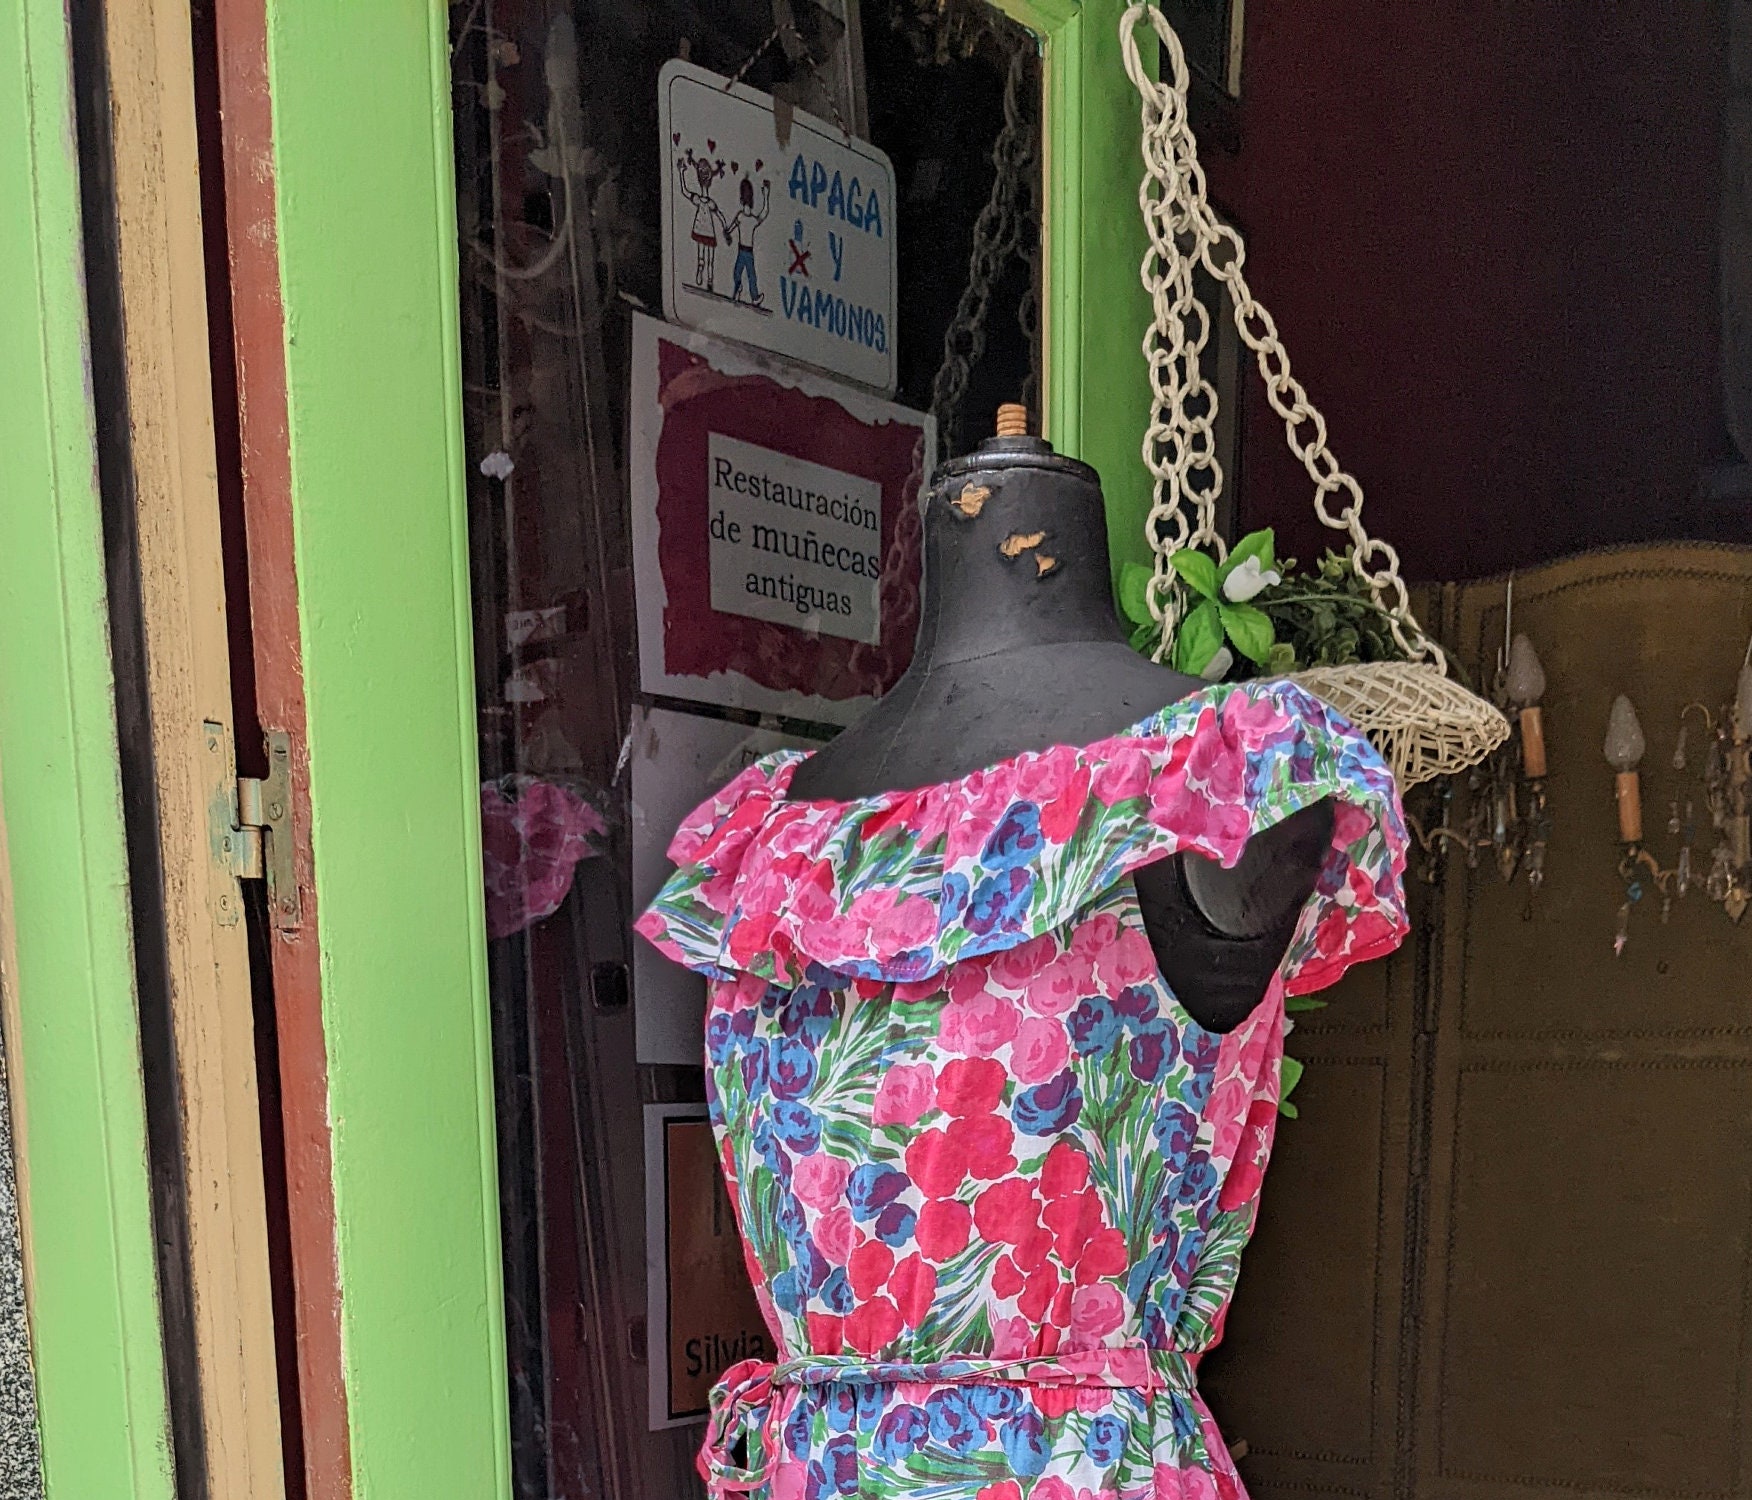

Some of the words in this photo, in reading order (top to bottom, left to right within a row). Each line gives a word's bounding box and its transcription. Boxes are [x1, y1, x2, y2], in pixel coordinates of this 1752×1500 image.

[788, 152, 883, 238] APAGA
[829, 230, 843, 282] Y
[714, 457, 878, 531] Restauración
[710, 510, 741, 543] de
[752, 524, 880, 579] muñecas
[745, 572, 852, 616] antiguas
[685, 1329, 764, 1377] Silvia
